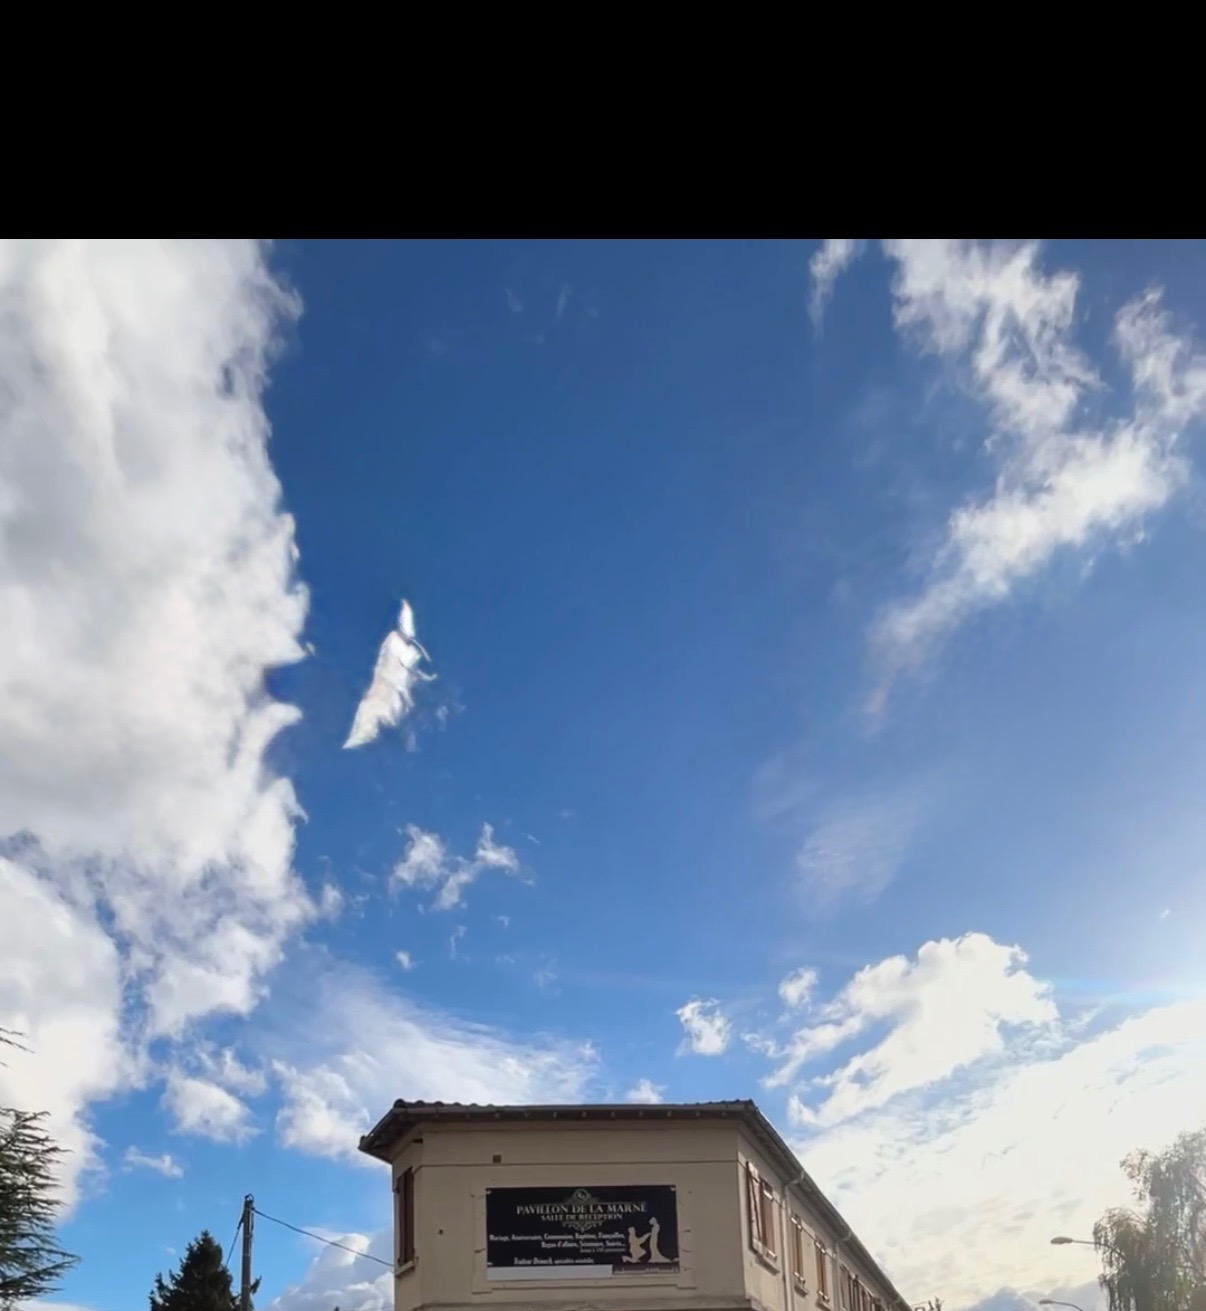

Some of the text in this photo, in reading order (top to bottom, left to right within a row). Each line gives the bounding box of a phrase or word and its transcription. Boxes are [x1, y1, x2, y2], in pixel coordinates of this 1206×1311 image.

[516, 1202, 647, 1215] PAVILLON DE LA MARNE
